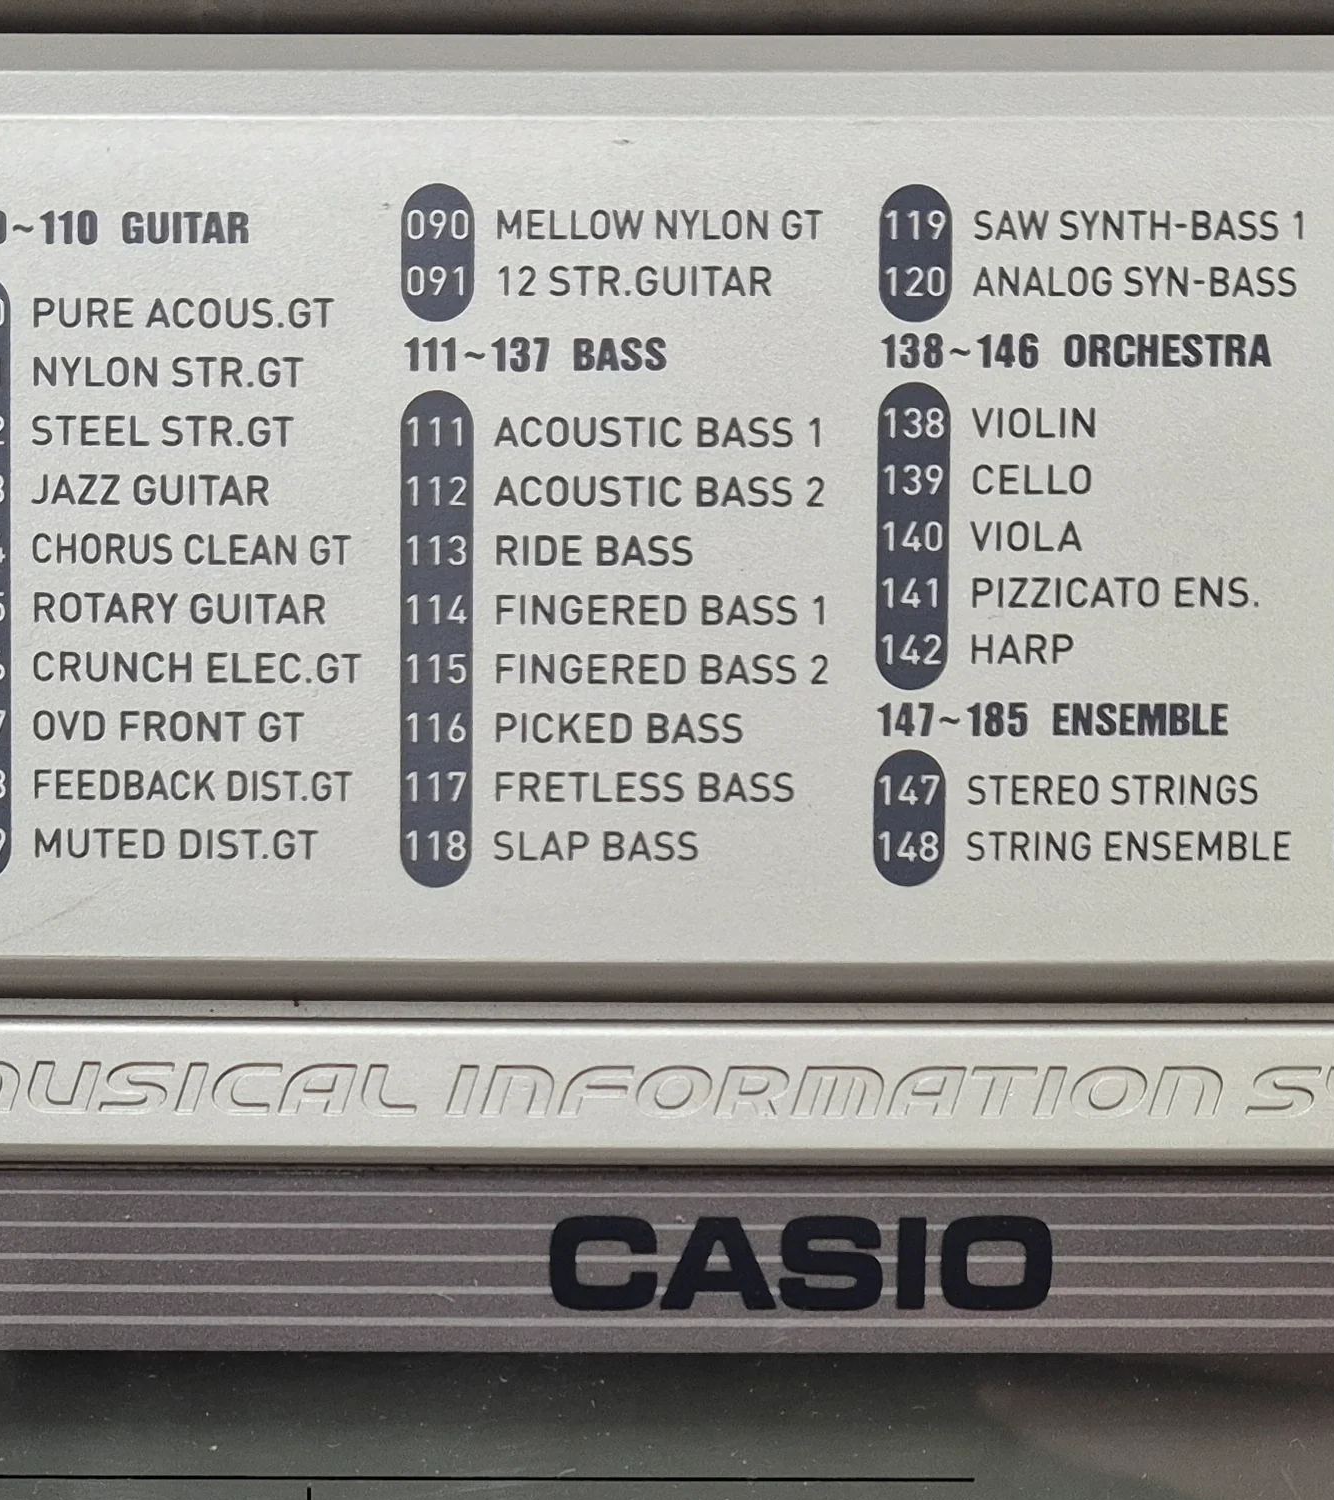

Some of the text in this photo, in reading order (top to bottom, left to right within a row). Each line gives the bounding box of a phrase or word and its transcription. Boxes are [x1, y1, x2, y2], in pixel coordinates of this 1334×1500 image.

[121, 211, 249, 245] GUITAR
[406, 265, 772, 297] 091 12 STR.GUITAR
[404, 336, 667, 373] 111~137 BASS
[881, 332, 1272, 369] 138~146 ORCHESTRA
[33, 356, 158, 388] NYLON
[172, 356, 304, 388] STR.GT
[882, 575, 1263, 609] 141 PIZZICATO ENS.
[877, 701, 1229, 738] 147~185 ENSEMBLE
[406, 771, 795, 803] 117 FRETLESS BASS
[444, 1062, 1223, 1119] INFORMATION
[548, 1214, 1053, 1312] CASIO
